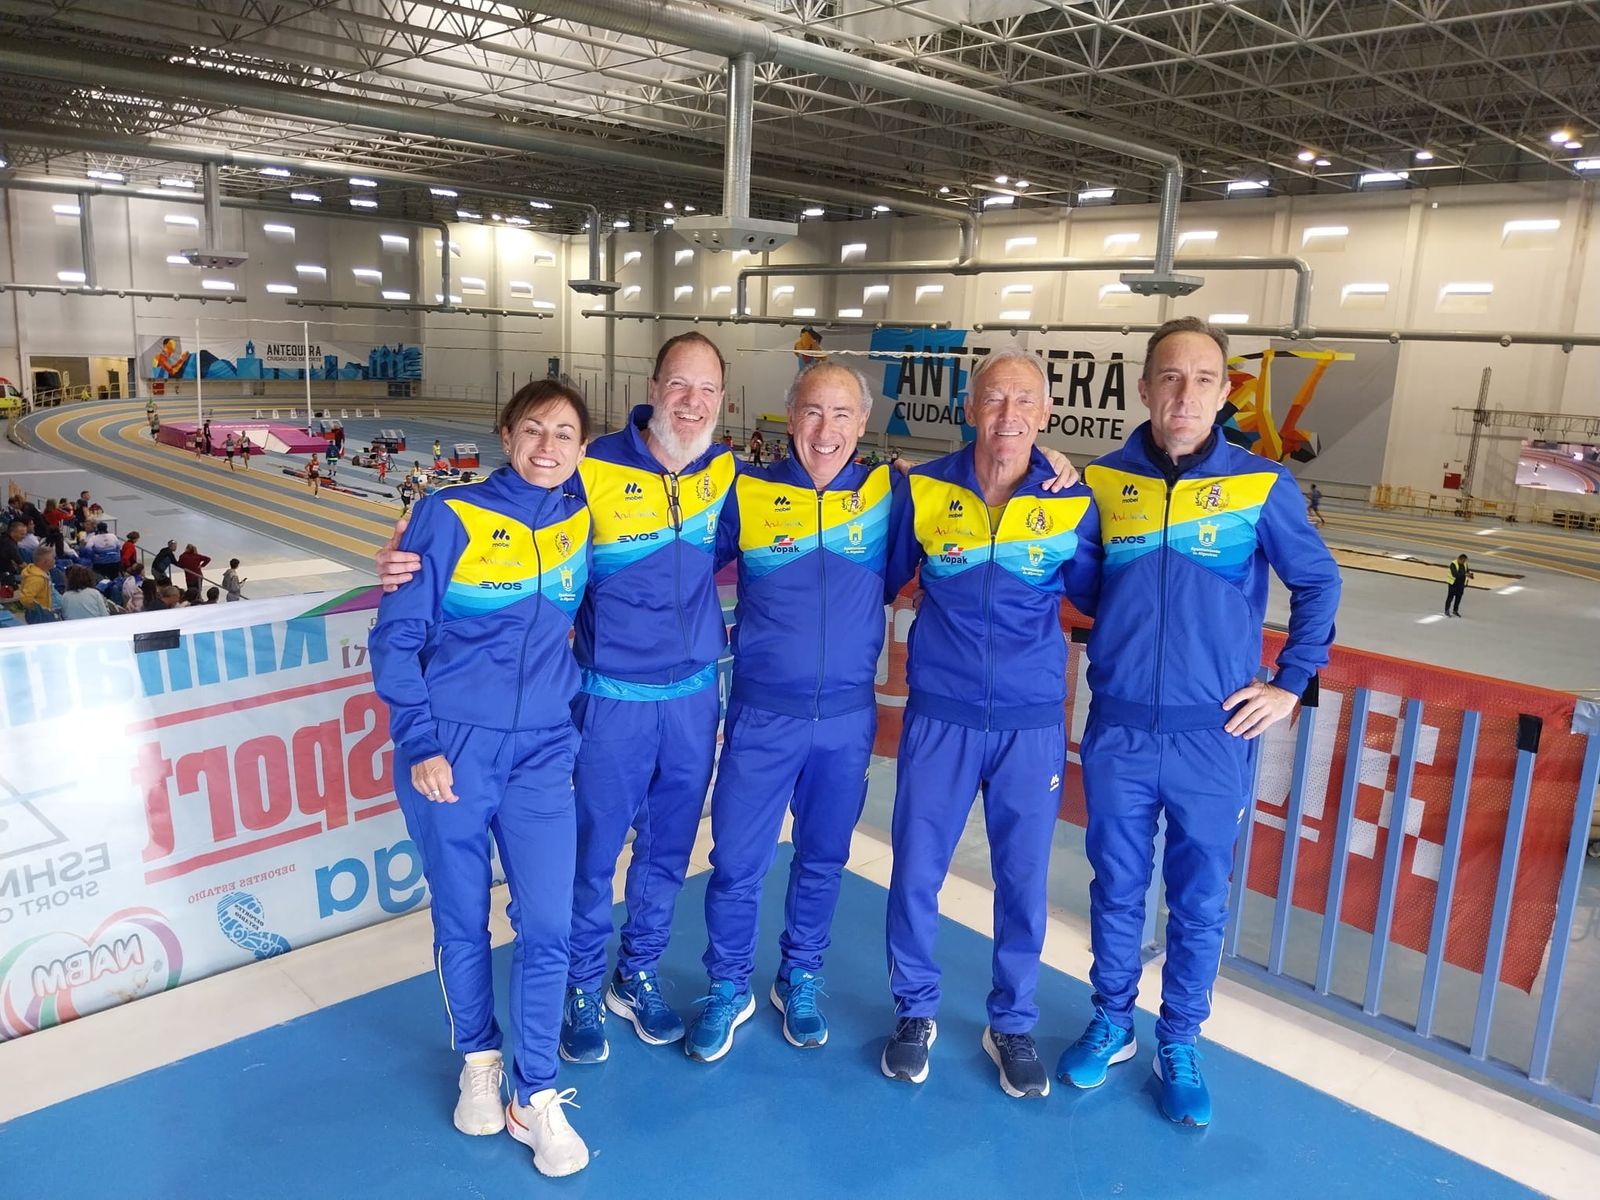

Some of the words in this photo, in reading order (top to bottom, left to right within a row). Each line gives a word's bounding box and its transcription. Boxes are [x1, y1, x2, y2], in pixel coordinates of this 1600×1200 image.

[267, 344, 322, 357] ANTEQURA
[896, 344, 1126, 411] ANTERA
[893, 401, 966, 426] CIUDAD
[1037, 412, 1125, 440] PORTE
[617, 532, 659, 543] EVOS
[1110, 535, 1146, 544] EVOS
[769, 545, 800, 554] Vopak
[940, 554, 968, 565] Vopak
[479, 580, 522, 591] EVOS
